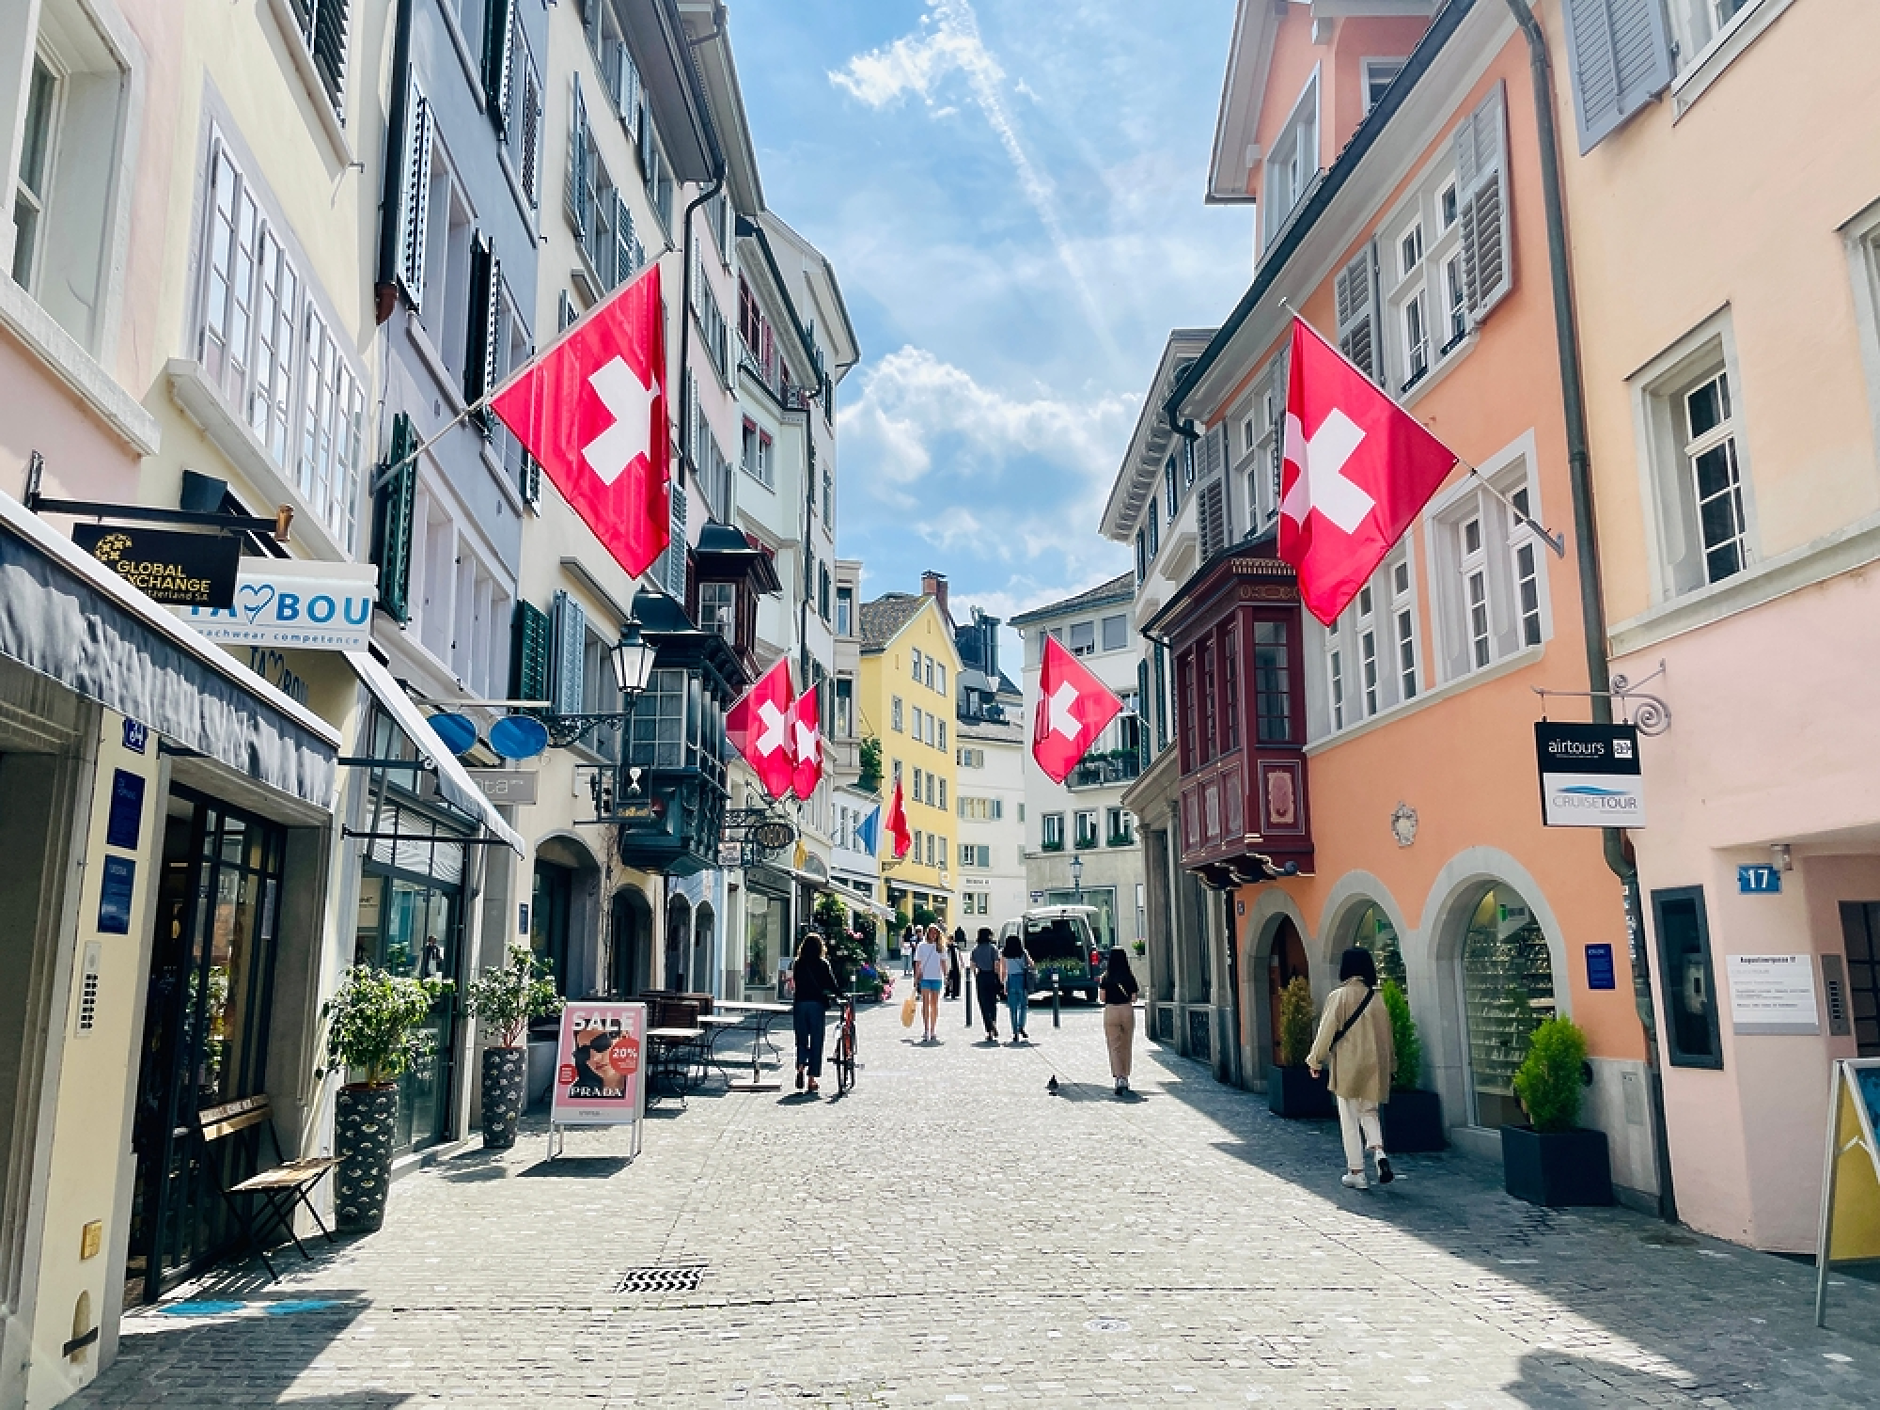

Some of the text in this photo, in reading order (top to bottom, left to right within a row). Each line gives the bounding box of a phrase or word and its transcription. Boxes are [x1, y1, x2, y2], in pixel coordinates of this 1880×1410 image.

[116, 560, 187, 577] GLOBAL
[274, 632, 360, 645] competence
[1548, 739, 1605, 754] airtours
[1552, 795, 1638, 809] CRUISETOUR
[1748, 868, 1769, 888] 17
[571, 1011, 636, 1031] SALE
[613, 1047, 638, 1058] 20%
[571, 1086, 623, 1097] PRADA
